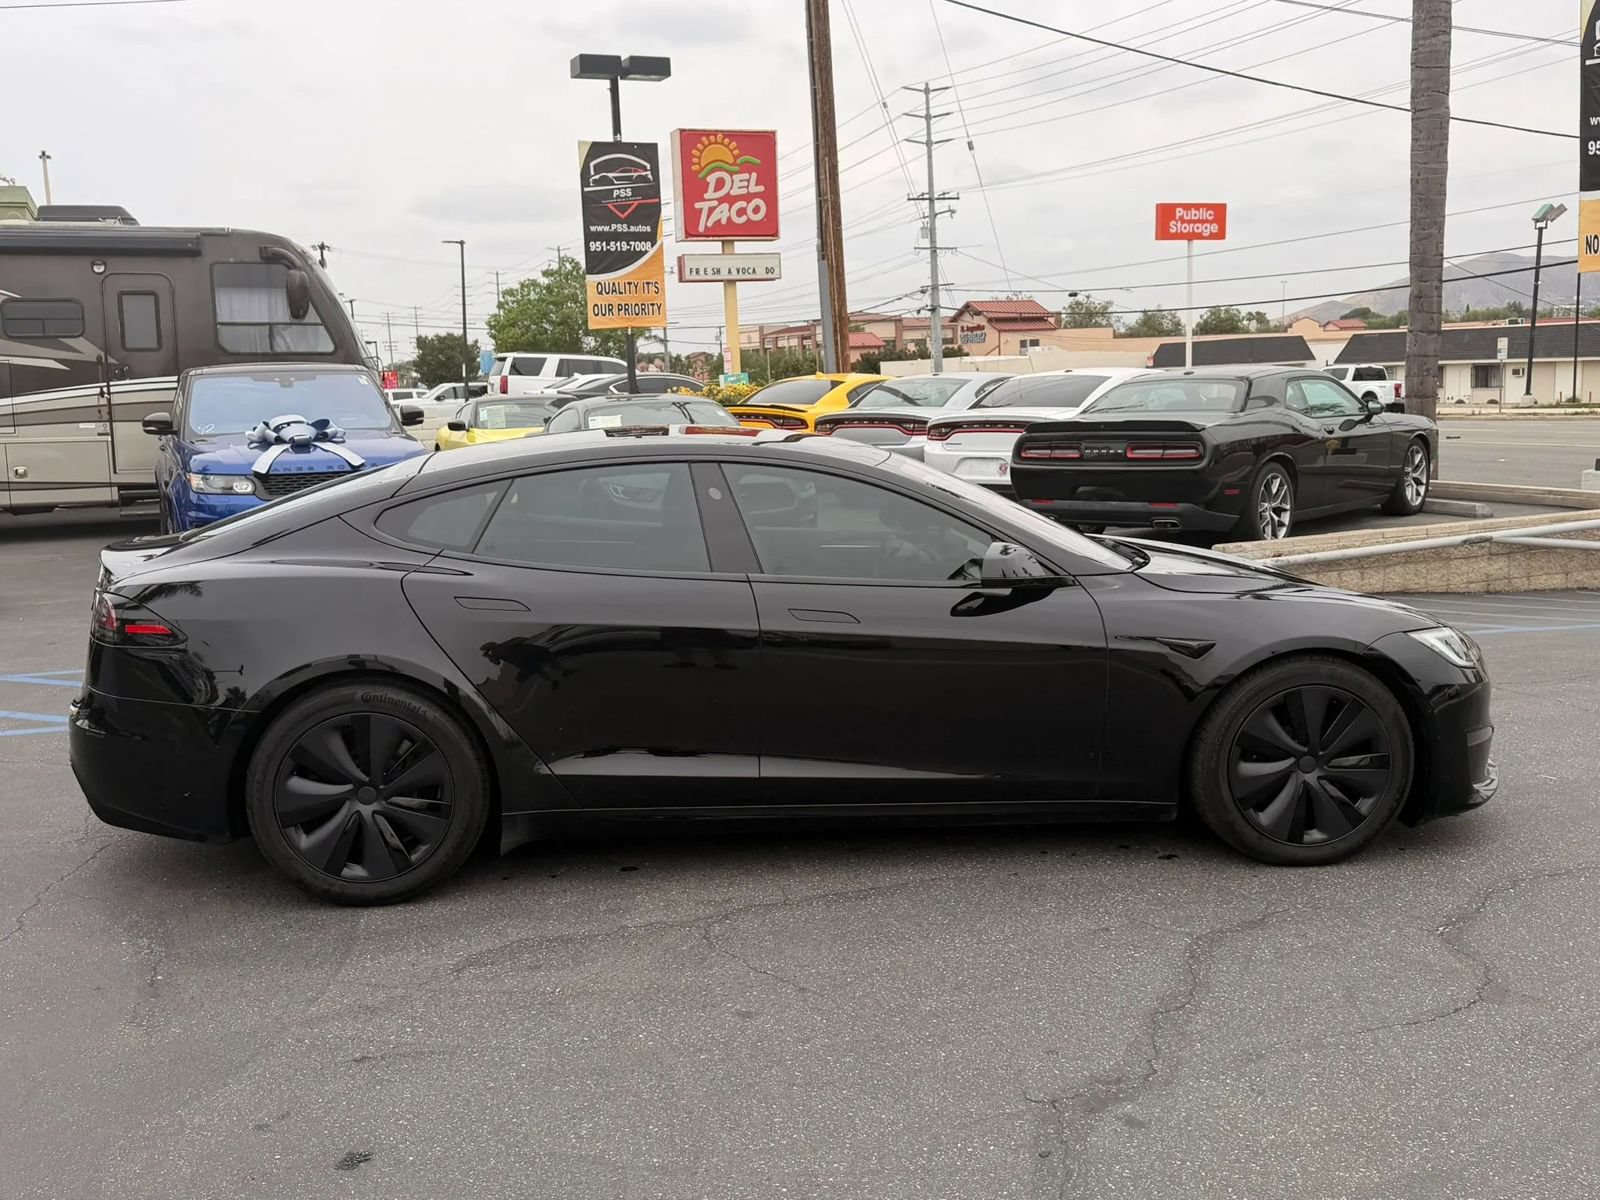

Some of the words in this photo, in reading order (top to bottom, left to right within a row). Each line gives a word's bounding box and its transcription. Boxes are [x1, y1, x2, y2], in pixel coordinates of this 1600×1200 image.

[703, 171, 765, 200] DEL
[613, 188, 632, 198] PSS
[694, 198, 767, 233] TACO
[1175, 208, 1215, 220] Public
[589, 224, 652, 232] www.PSS.autos
[1169, 220, 1219, 237] Storage
[589, 241, 652, 251] 951-519-7008
[689, 267, 721, 276] FRESH
[596, 281, 639, 295] QUALITY
[642, 281, 660, 295] IT'S
[592, 303, 614, 317] OUR
[617, 303, 662, 316] PRIORITY
[360, 691, 421, 713] Continental
